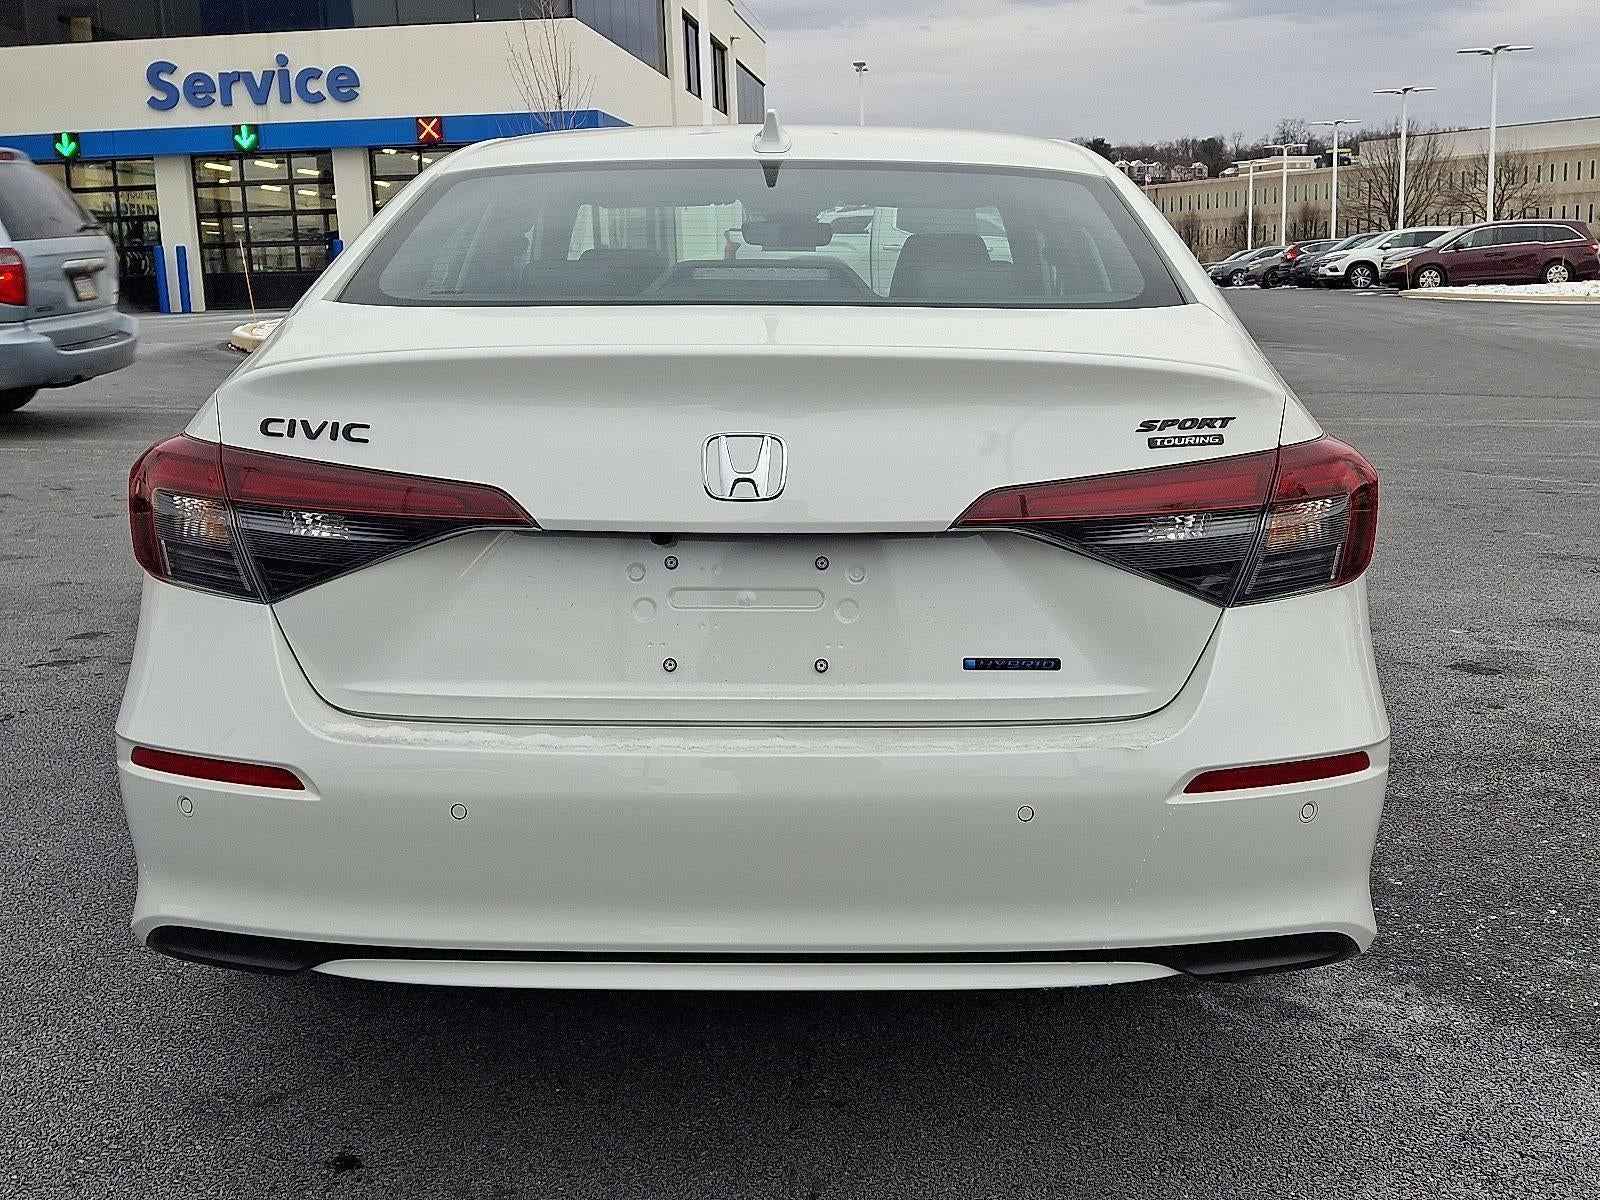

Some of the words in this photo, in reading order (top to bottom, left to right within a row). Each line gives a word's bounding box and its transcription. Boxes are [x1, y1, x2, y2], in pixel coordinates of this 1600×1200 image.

[146, 53, 361, 111] Service
[259, 417, 371, 443] CIVIC
[1135, 416, 1237, 433] SPORT
[1155, 436, 1220, 446] TOURING
